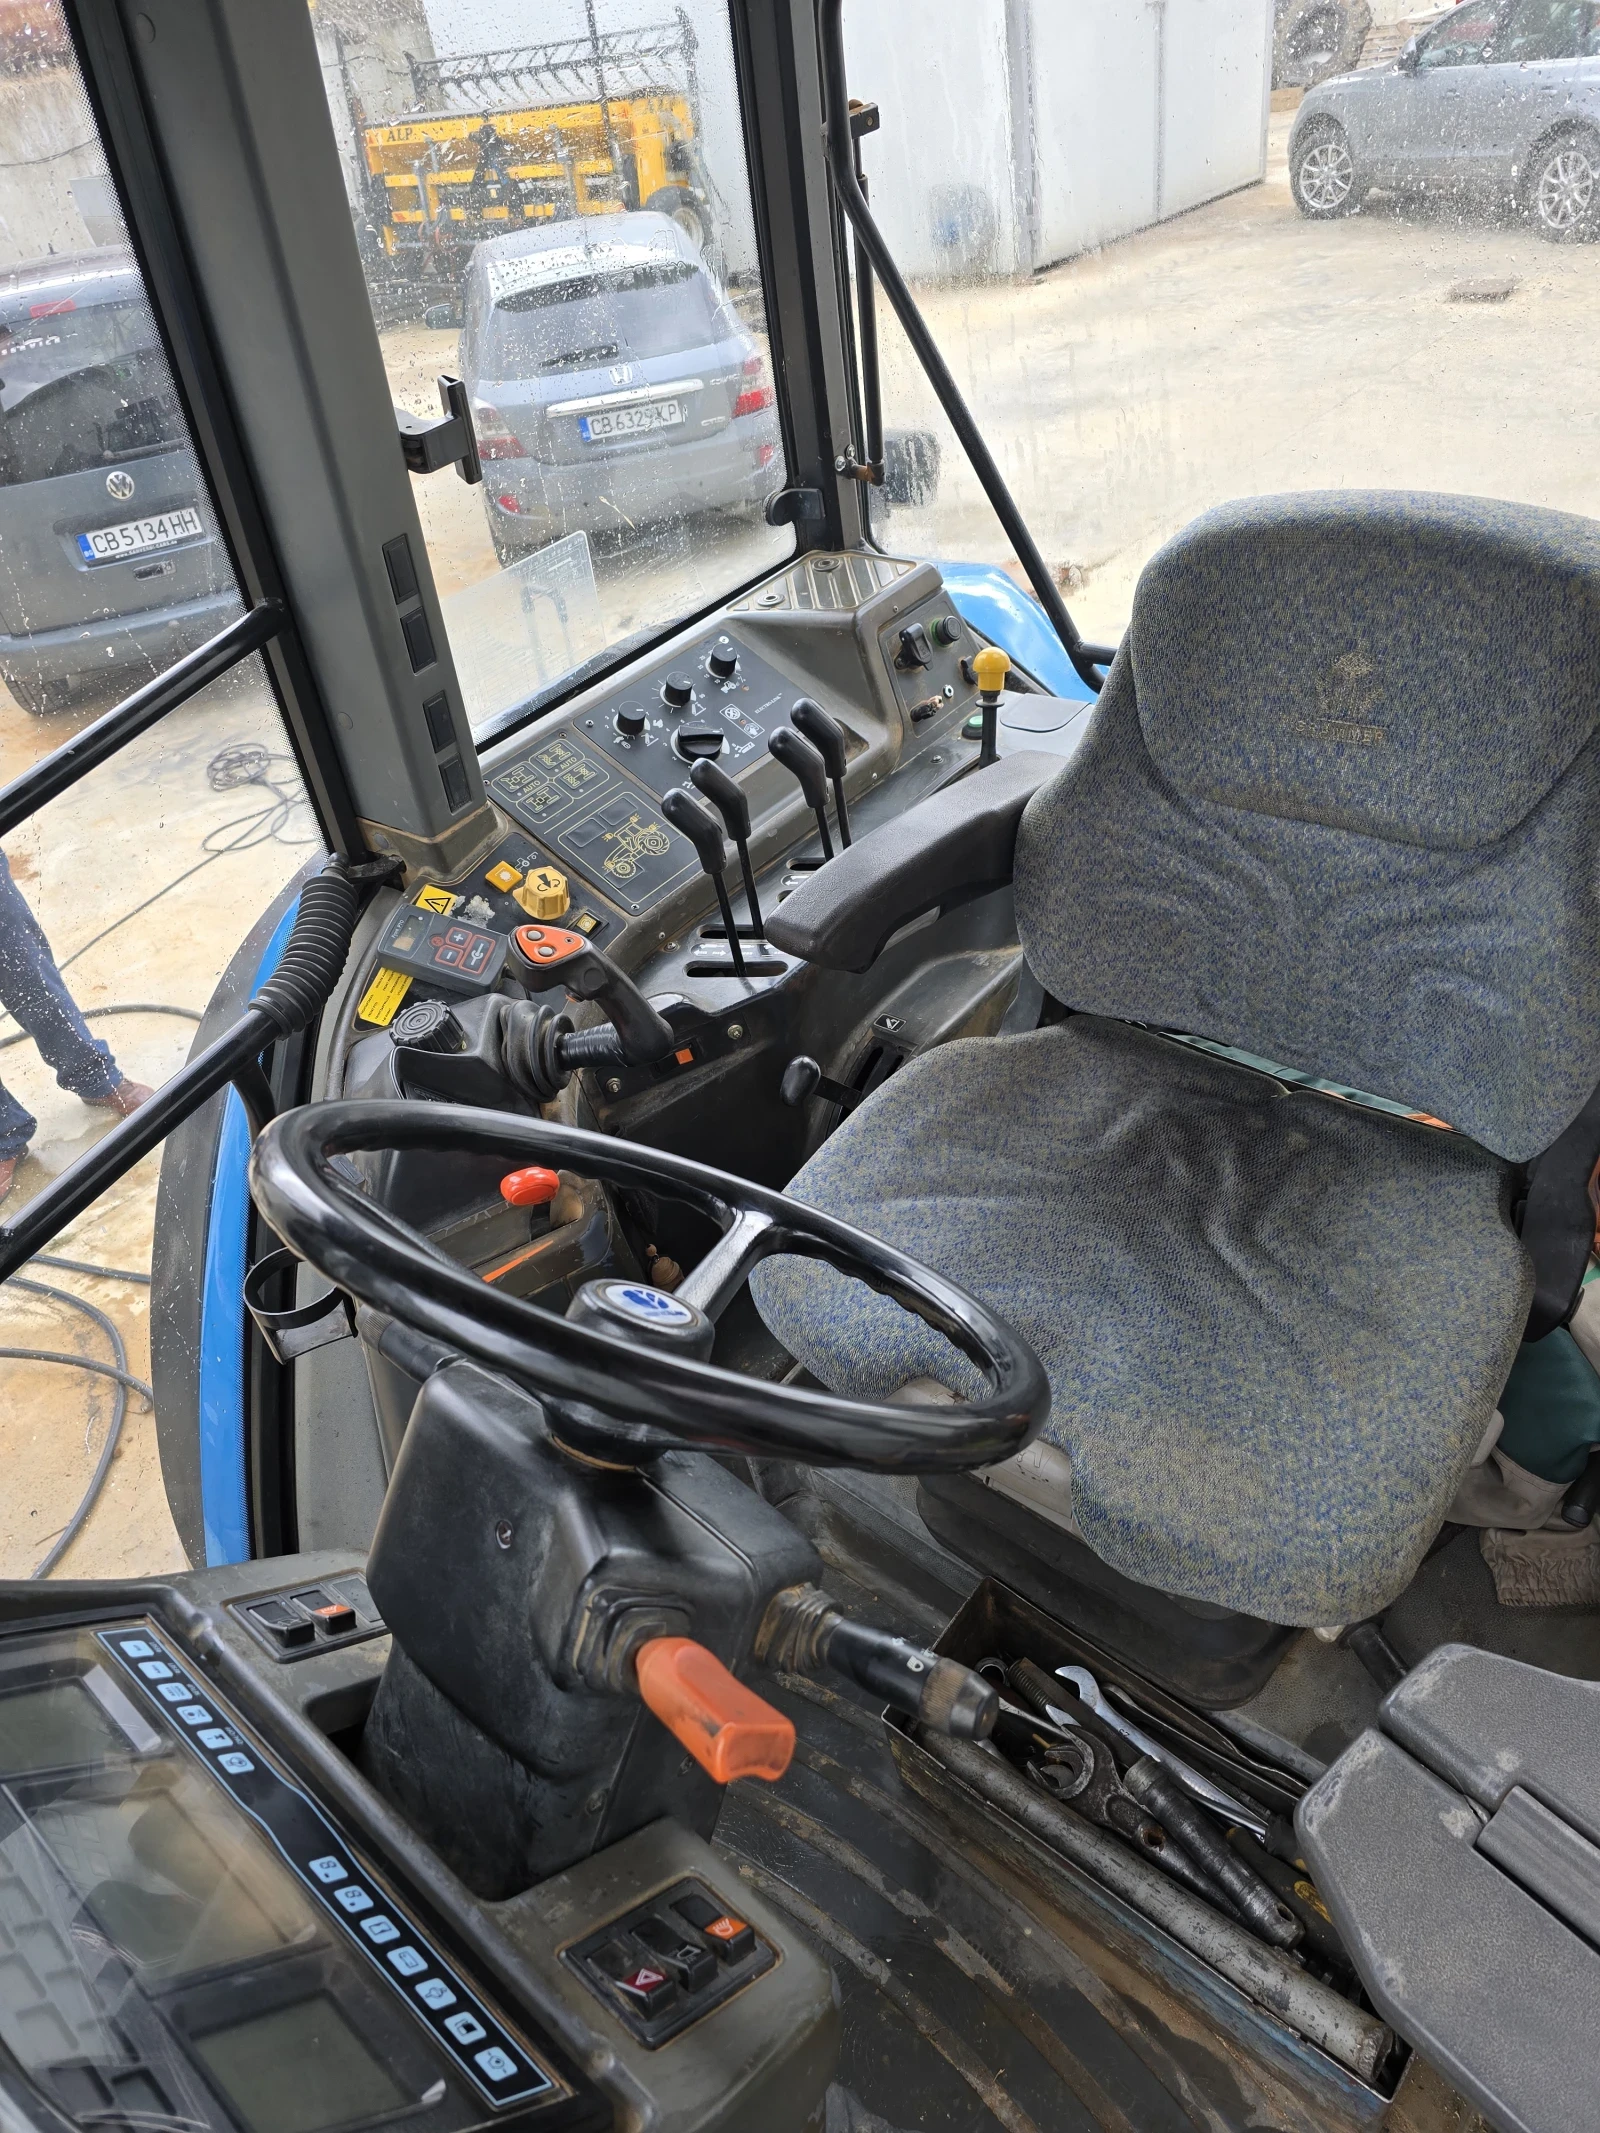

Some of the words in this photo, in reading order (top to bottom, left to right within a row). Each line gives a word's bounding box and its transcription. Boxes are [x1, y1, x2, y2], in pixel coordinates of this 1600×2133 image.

[590, 416, 613, 436] CB
[92, 532, 120, 554] CB
[119, 518, 169, 547] 5134
[168, 511, 198, 536] HH
[560, 756, 577, 770] AUTO
[522, 780, 541, 794] AUTO
